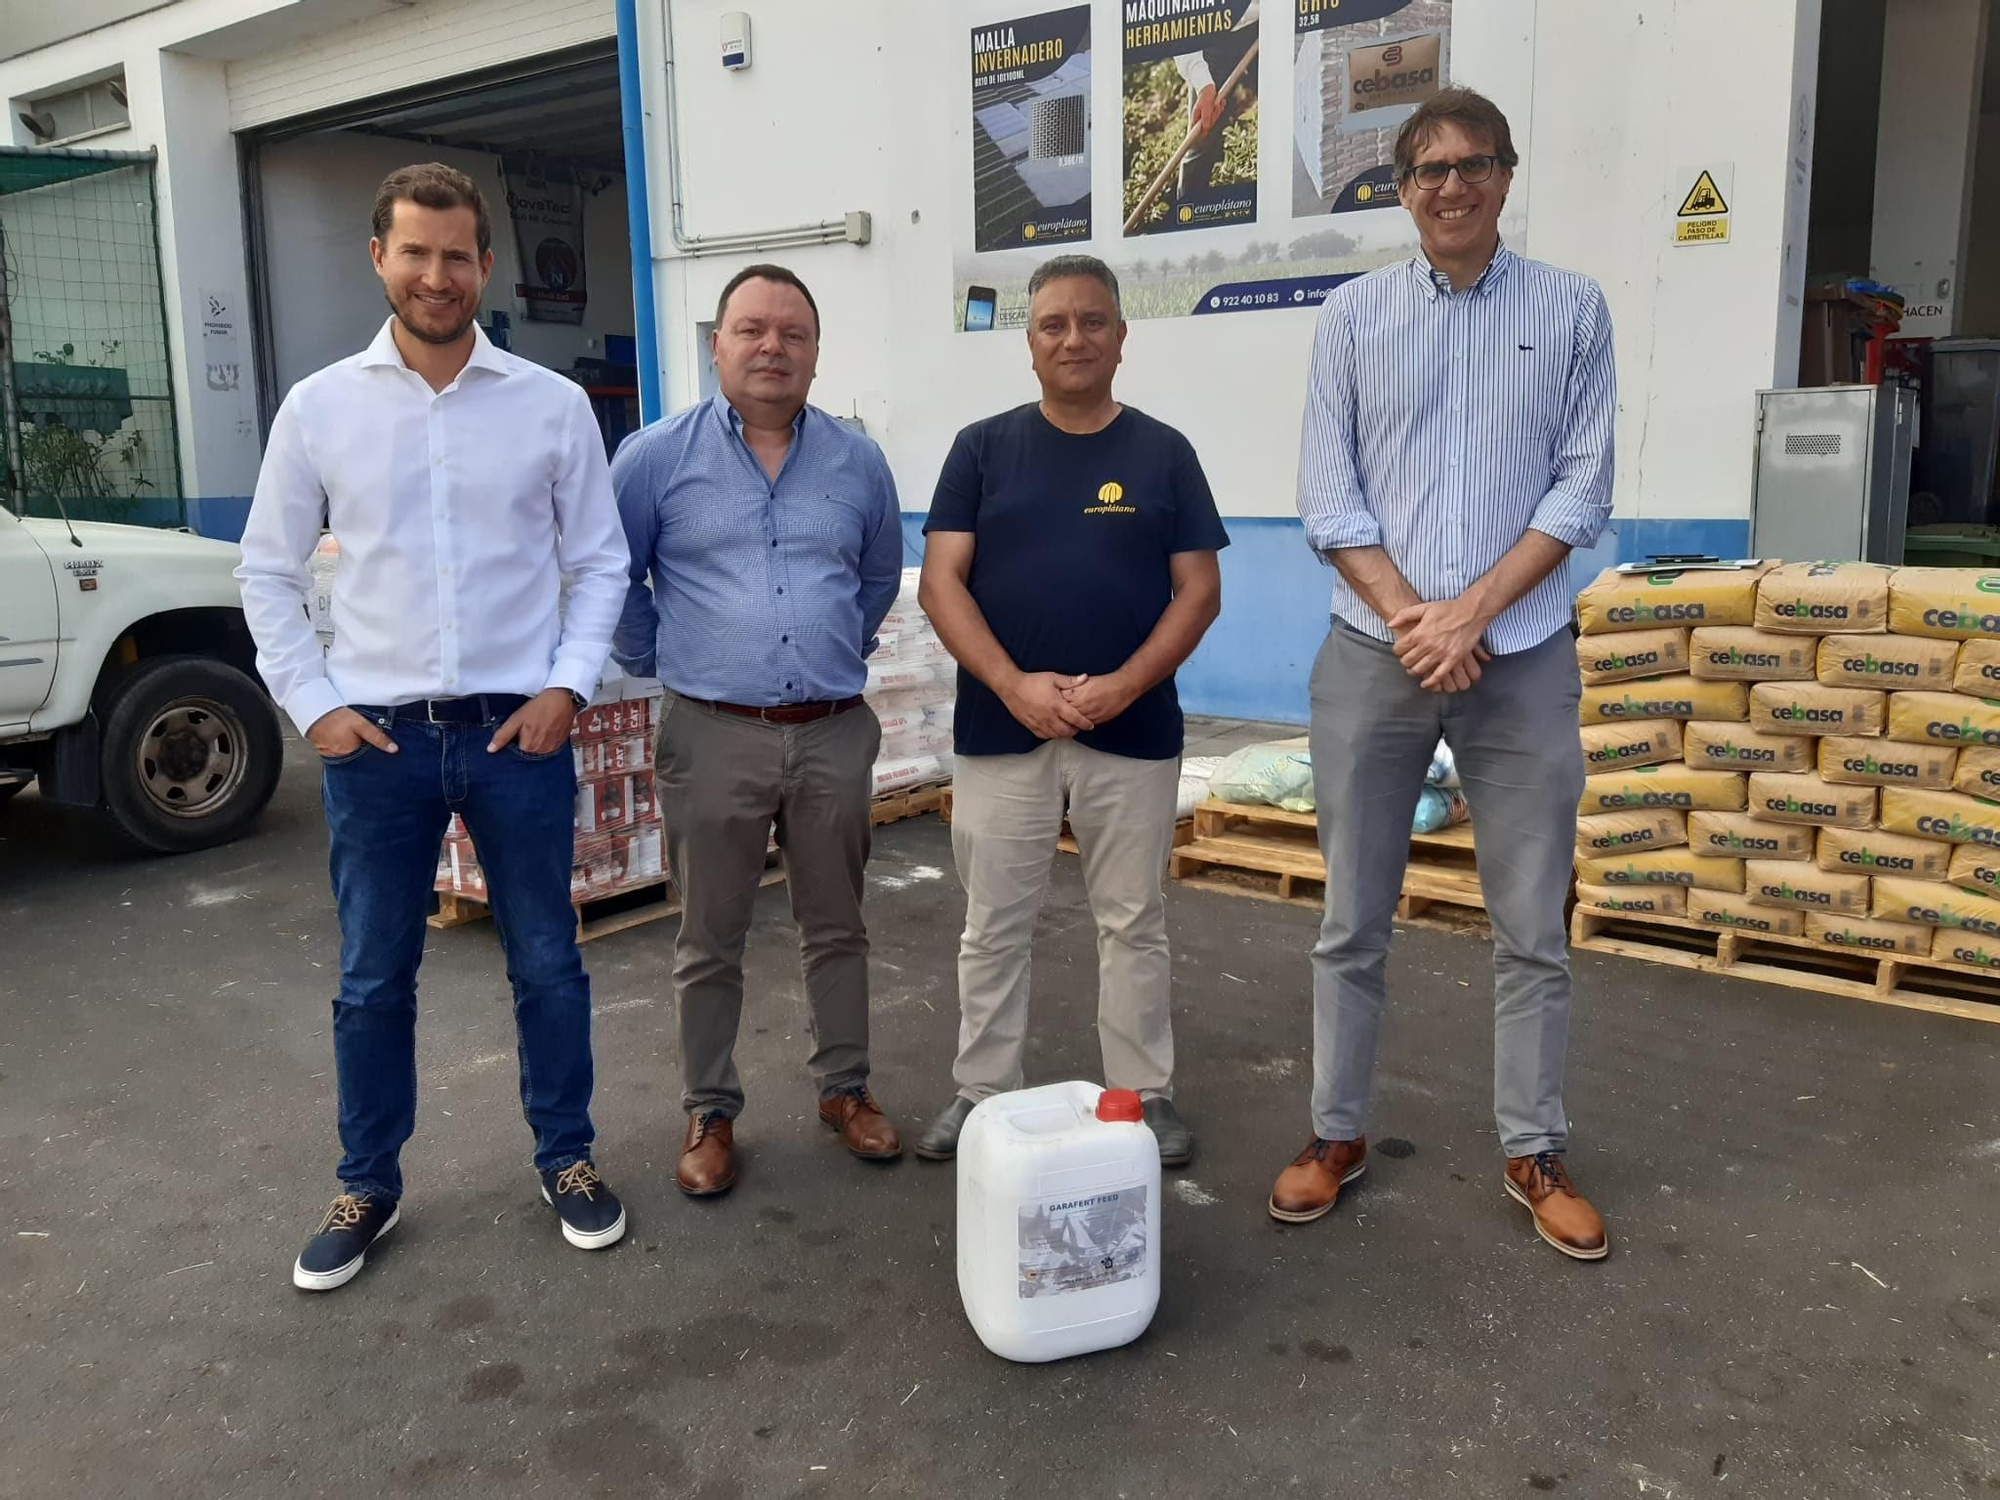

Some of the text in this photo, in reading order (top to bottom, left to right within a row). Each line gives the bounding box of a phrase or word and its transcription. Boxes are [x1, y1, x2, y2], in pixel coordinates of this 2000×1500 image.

[975, 27, 1015, 53] MALLA
[1126, 9, 1232, 49] HERRAMIENTAS
[975, 38, 1063, 74] INVERNADERO
[1353, 67, 1433, 95] cebasa
[1194, 199, 1252, 215] europlátano
[1037, 218, 1088, 233] europlátano
[1687, 220, 1717, 228] PELIGRO
[1687, 227, 1706, 235] PASO
[1678, 231, 1725, 241] CARRETILLAS
[1223, 295, 1239, 307] 922
[1241, 294, 1253, 305] 40
[1255, 293, 1266, 304] 10
[1267, 292, 1279, 303] 83
[1083, 504, 1136, 515] europlátano
[1607, 597, 1705, 623] cebasa
[1774, 597, 1848, 619] cebasa
[1594, 651, 1658, 671] cebasa
[1709, 646, 1780, 668] cebasa
[1843, 652, 1919, 676] cebasa
[1598, 694, 1693, 717] cebasa
[1771, 701, 1843, 722] cebasa
[1588, 741, 1651, 762] cebasa
[1705, 740, 1775, 762] cebasa
[1843, 754, 1919, 777] cebasa
[1599, 785, 1692, 808] cebasa
[1766, 794, 1837, 816] cebasa
[1592, 828, 1654, 849] cebasa
[1709, 830, 1778, 850] cebasa
[1839, 847, 1913, 870] cebasa
[1603, 863, 1694, 886] cebasa
[1594, 896, 1655, 911] cebasa
[1761, 882, 1831, 905] cebasa
[1702, 908, 1770, 931] cebasa
[1906, 903, 2000, 938] cebas
[1823, 928, 1896, 950] cebasa
[1050, 1193, 1118, 1212] GARAFERT FEED
